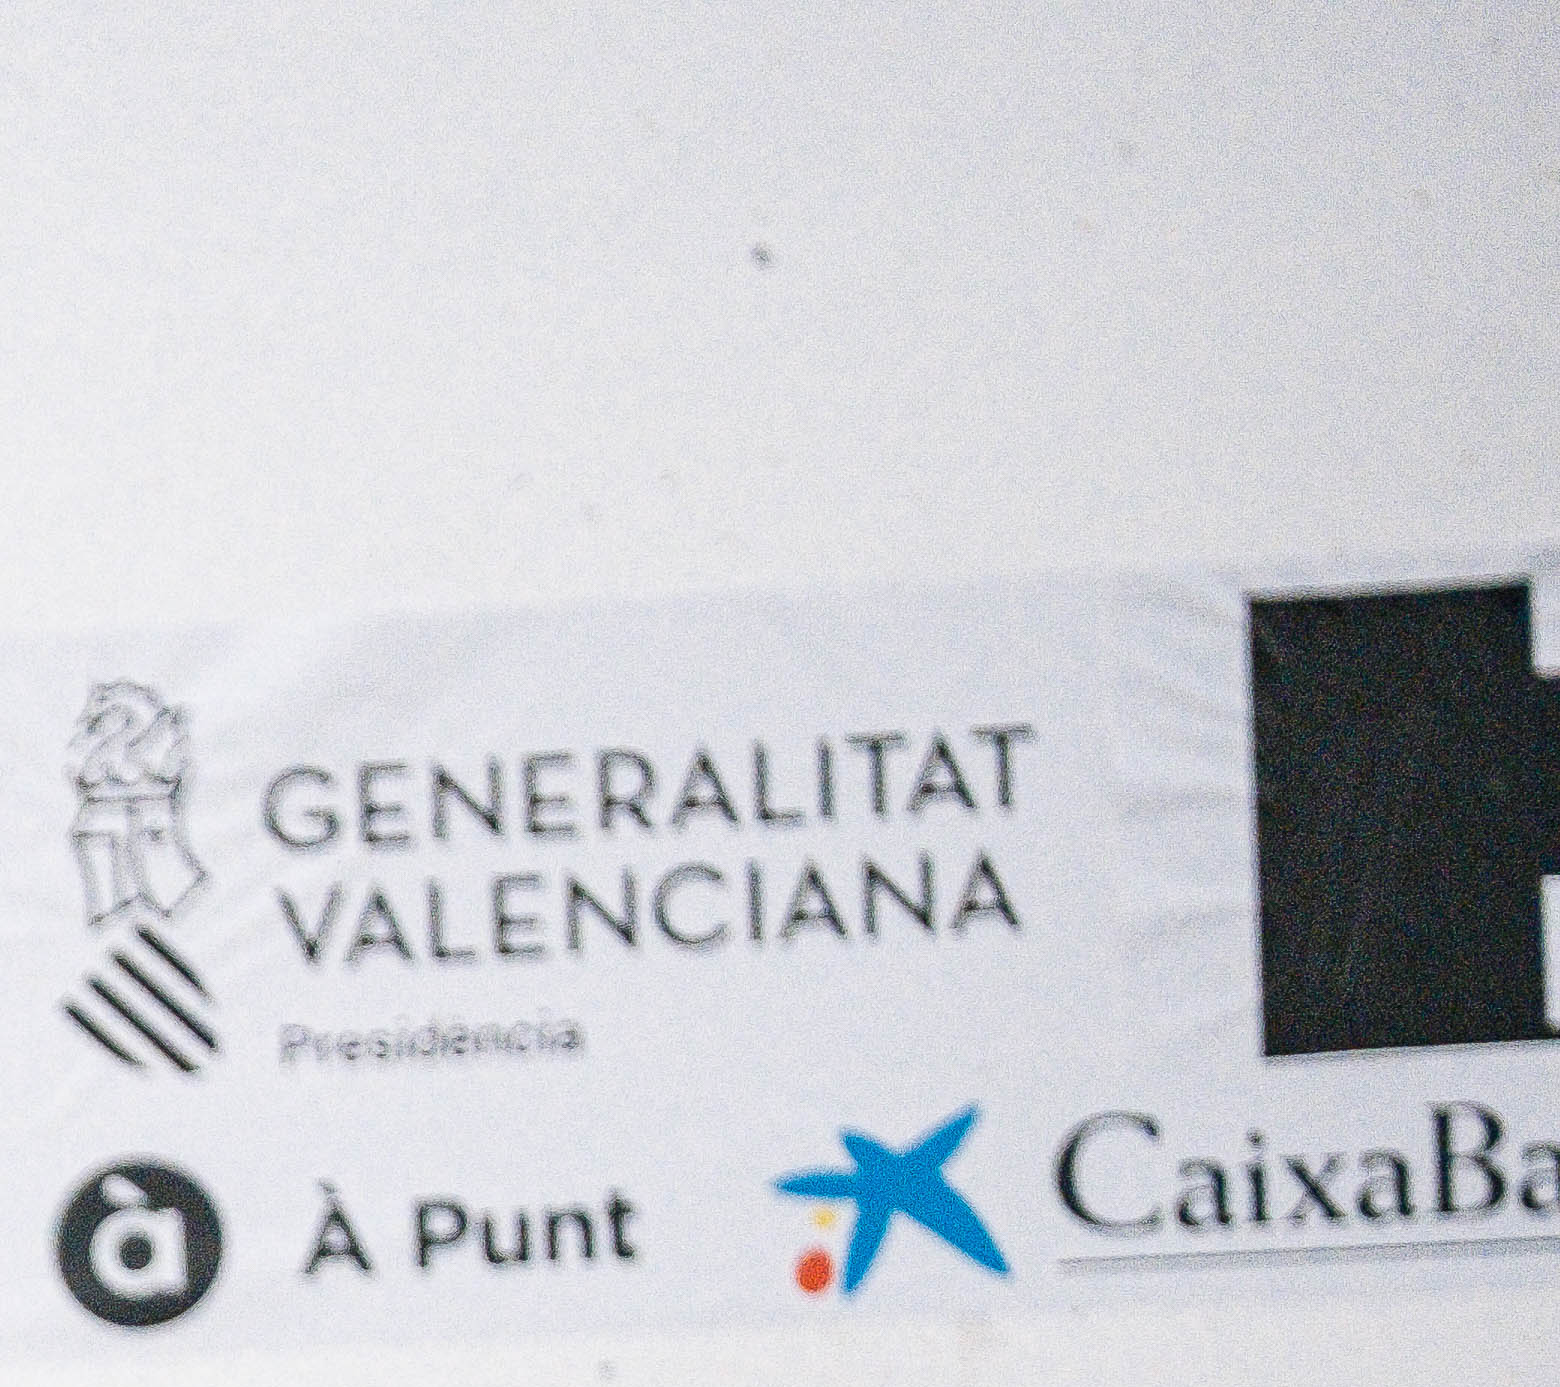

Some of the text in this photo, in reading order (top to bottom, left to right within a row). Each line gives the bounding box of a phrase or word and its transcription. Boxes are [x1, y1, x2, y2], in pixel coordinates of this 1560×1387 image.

[262, 723, 1036, 852] GENERALITAT
[274, 850, 1024, 966] VALENCIANA
[304, 1179, 638, 1275] À Punt
